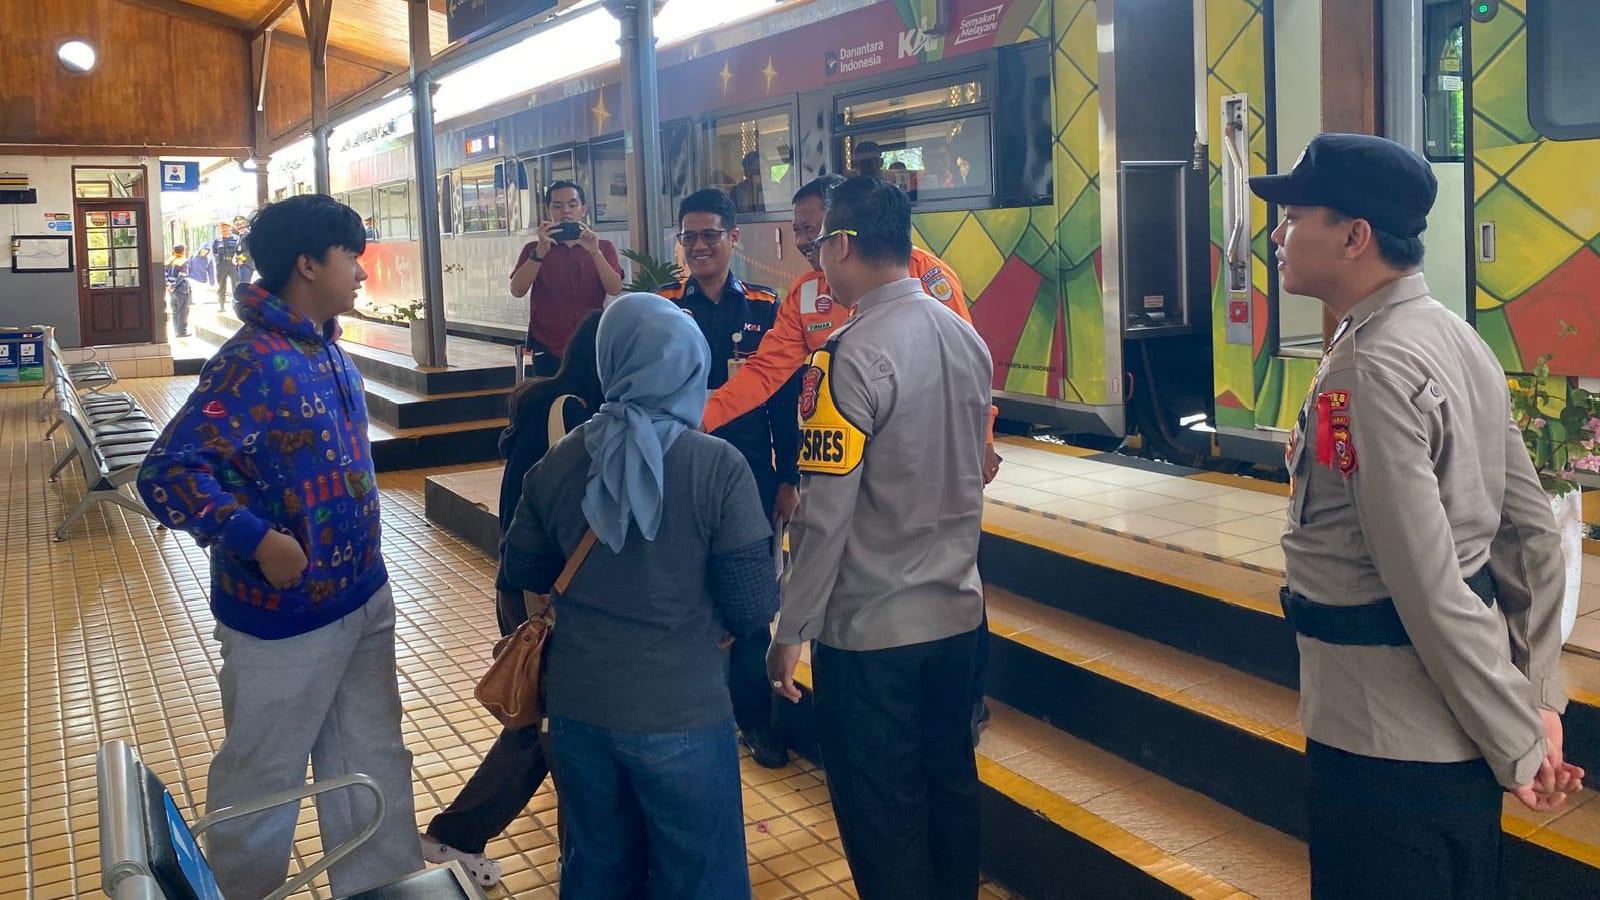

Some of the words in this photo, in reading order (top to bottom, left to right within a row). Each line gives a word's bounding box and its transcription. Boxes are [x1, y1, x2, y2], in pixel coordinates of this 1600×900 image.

[960, 13, 996, 28] Semakin
[960, 21, 997, 38] Melayani
[839, 40, 884, 60] Danantara
[840, 53, 882, 73] Indonesia
